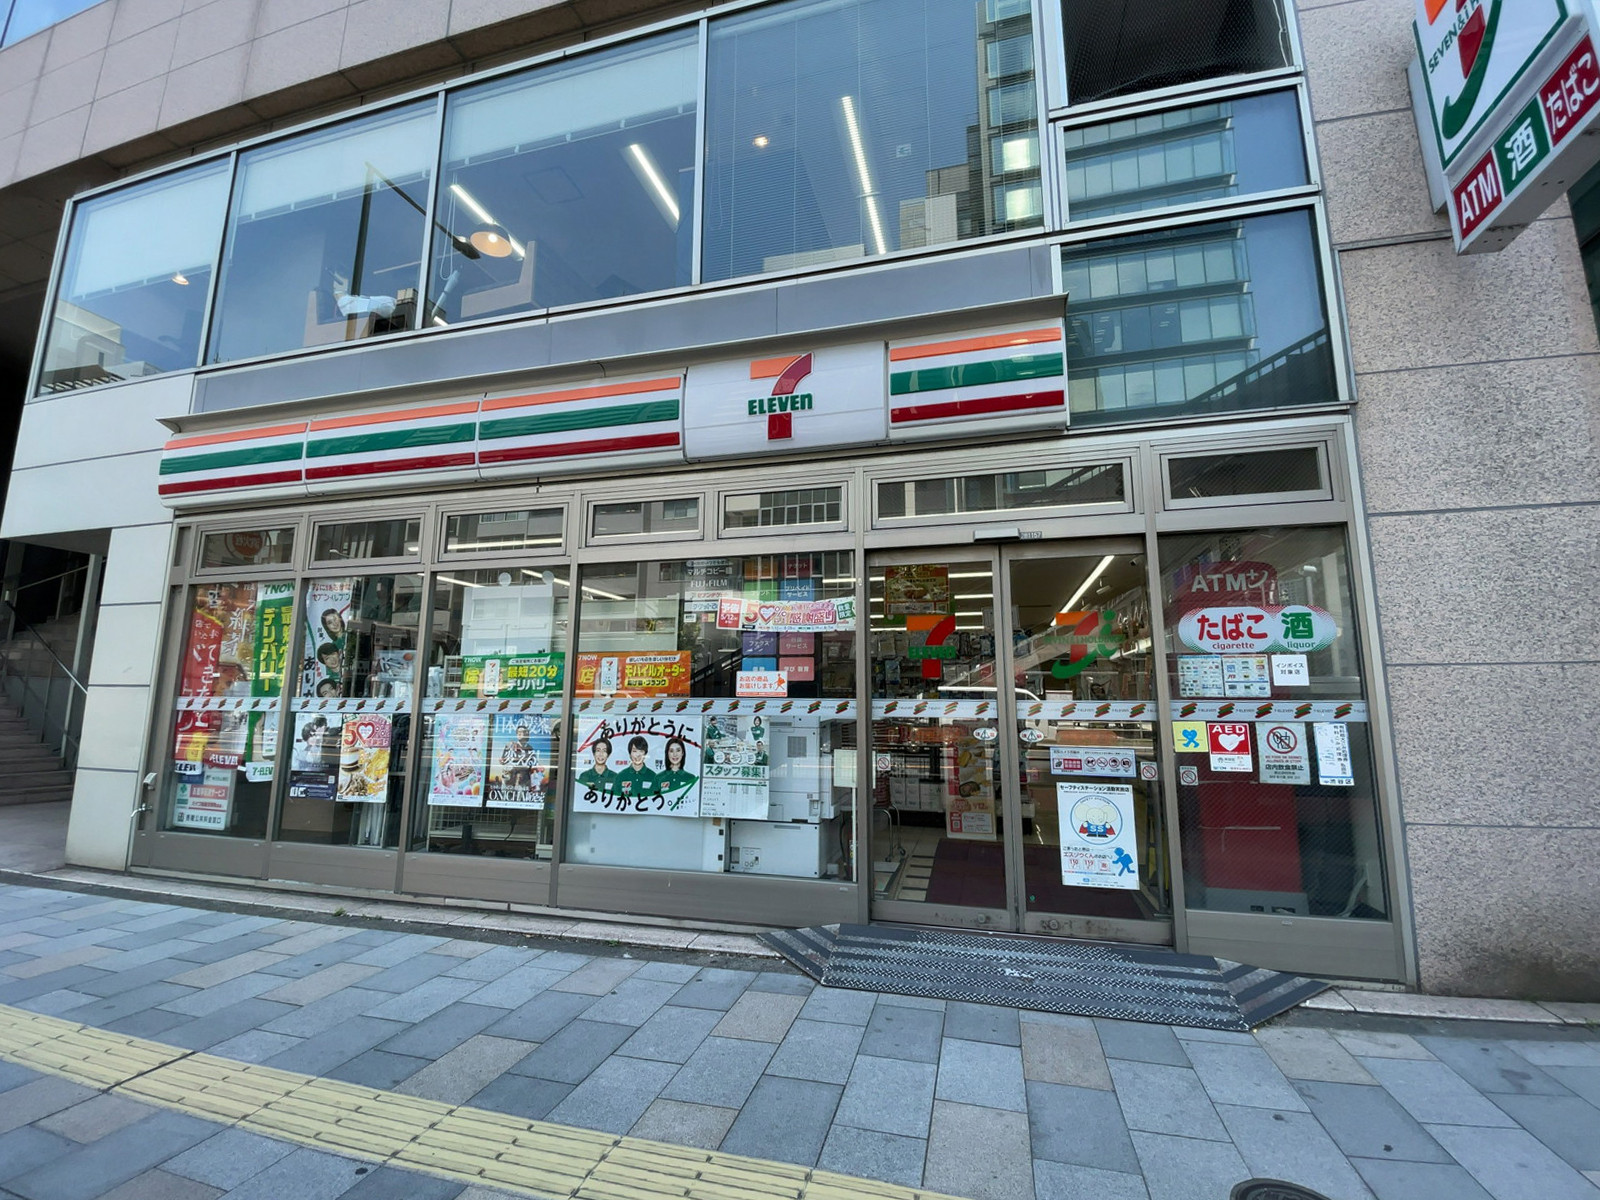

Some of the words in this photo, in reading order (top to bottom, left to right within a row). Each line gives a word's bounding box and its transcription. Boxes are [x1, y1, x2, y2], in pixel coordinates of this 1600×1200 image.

[1546, 52, 1599, 135] たばこ
[1504, 117, 1537, 181] 酒
[1459, 162, 1498, 230] ATM
[1191, 573, 1247, 593] ATM
[1197, 611, 1269, 641] たばこ
[1281, 611, 1314, 640] 酒
[260, 607, 278, 692] デリバリー
[1212, 642, 1255, 651] cigarette
[1286, 640, 1316, 649] liquor
[508, 665, 558, 679] 最短20分
[578, 667, 596, 685] 店
[625, 663, 686, 677] モバイルオーダー
[507, 678, 556, 691] デリバリー
[739, 675, 769, 683] お店の商品
[1211, 725, 1246, 734] AED
[705, 765, 761, 778] スタッフ募集
[583, 784, 673, 812] ありがとう。
[1090, 825, 1104, 833] SS
